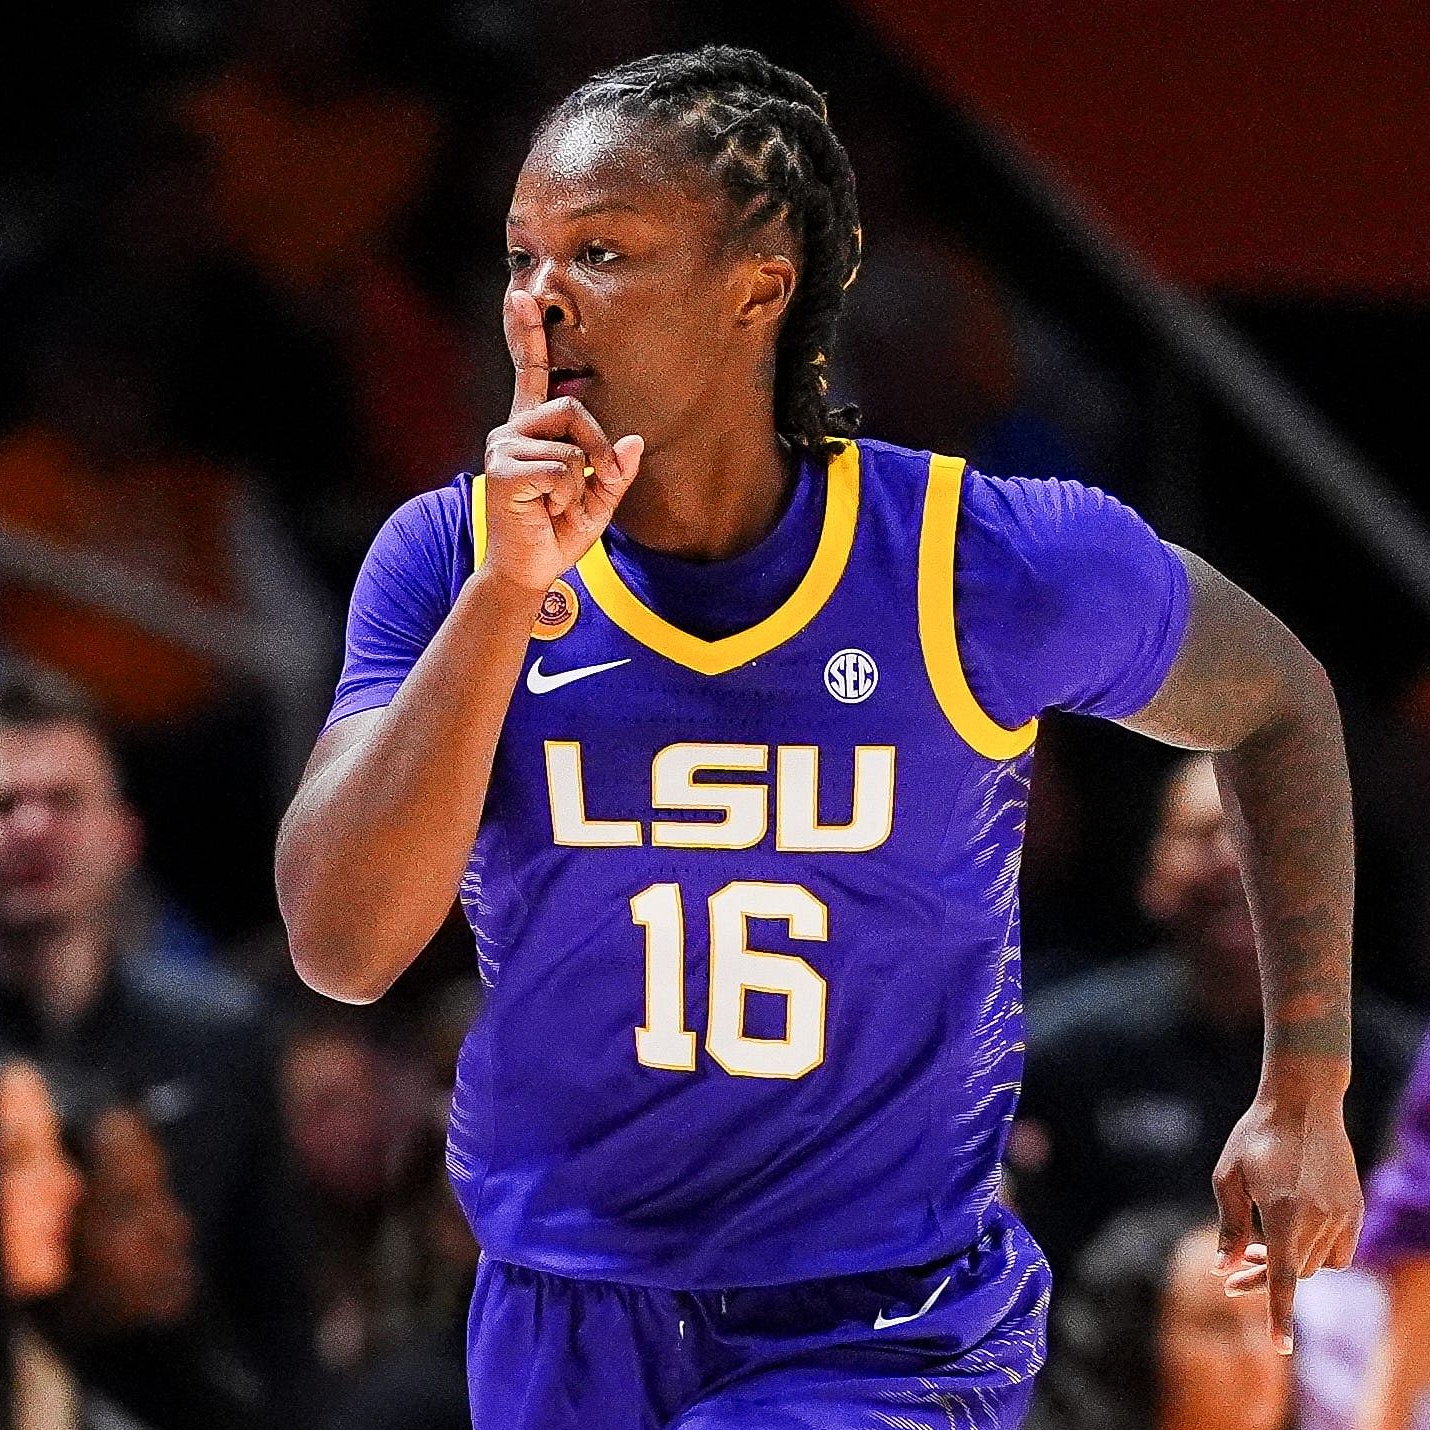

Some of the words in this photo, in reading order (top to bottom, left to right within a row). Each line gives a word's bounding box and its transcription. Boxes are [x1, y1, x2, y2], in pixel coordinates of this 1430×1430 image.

[829, 653, 873, 698] SEC
[543, 739, 897, 852] LSU
[629, 880, 829, 1081] 16
